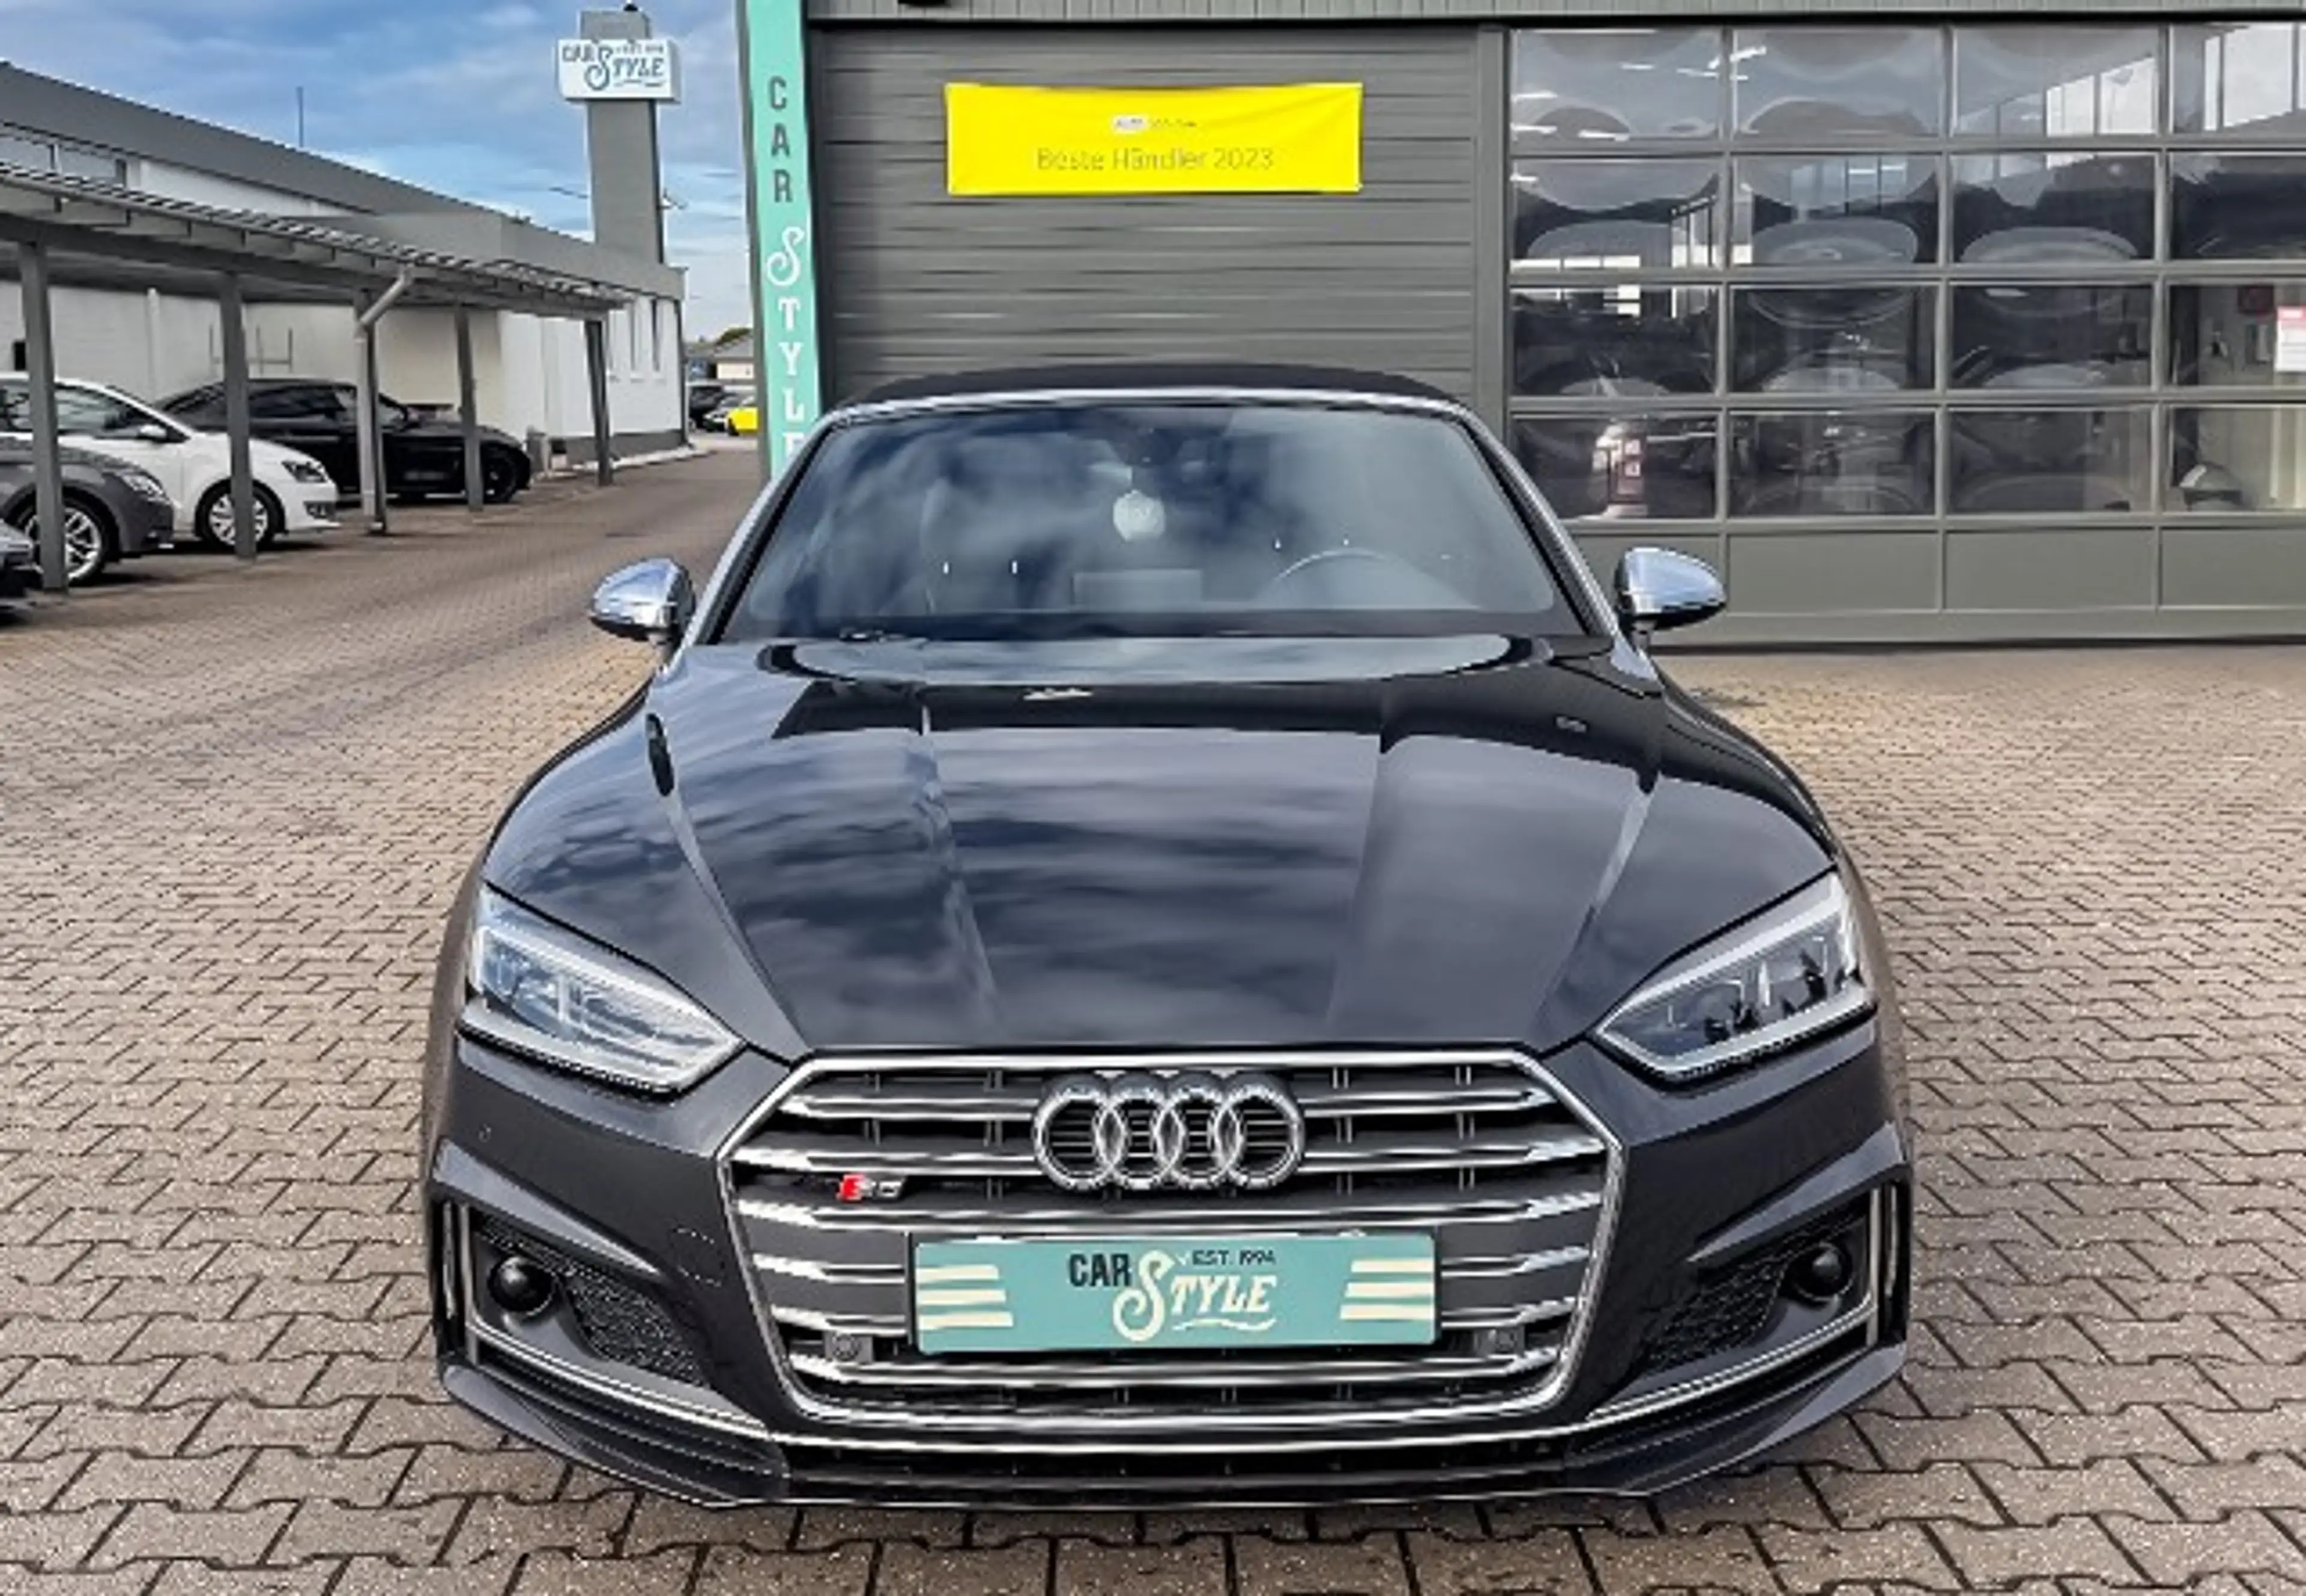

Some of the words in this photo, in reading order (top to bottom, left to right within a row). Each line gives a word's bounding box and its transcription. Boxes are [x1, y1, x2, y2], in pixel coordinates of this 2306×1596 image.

[584, 46, 664, 91] STYLE
[768, 75, 793, 203] CAR
[1037, 147, 1105, 171] Beste
[1112, 147, 1207, 171] Händler
[1213, 147, 1274, 171] 2023
[1239, 1250, 1276, 1265] 1994
[1068, 1253, 1132, 1287] CAR
[1113, 1250, 1277, 1341] STYLE
